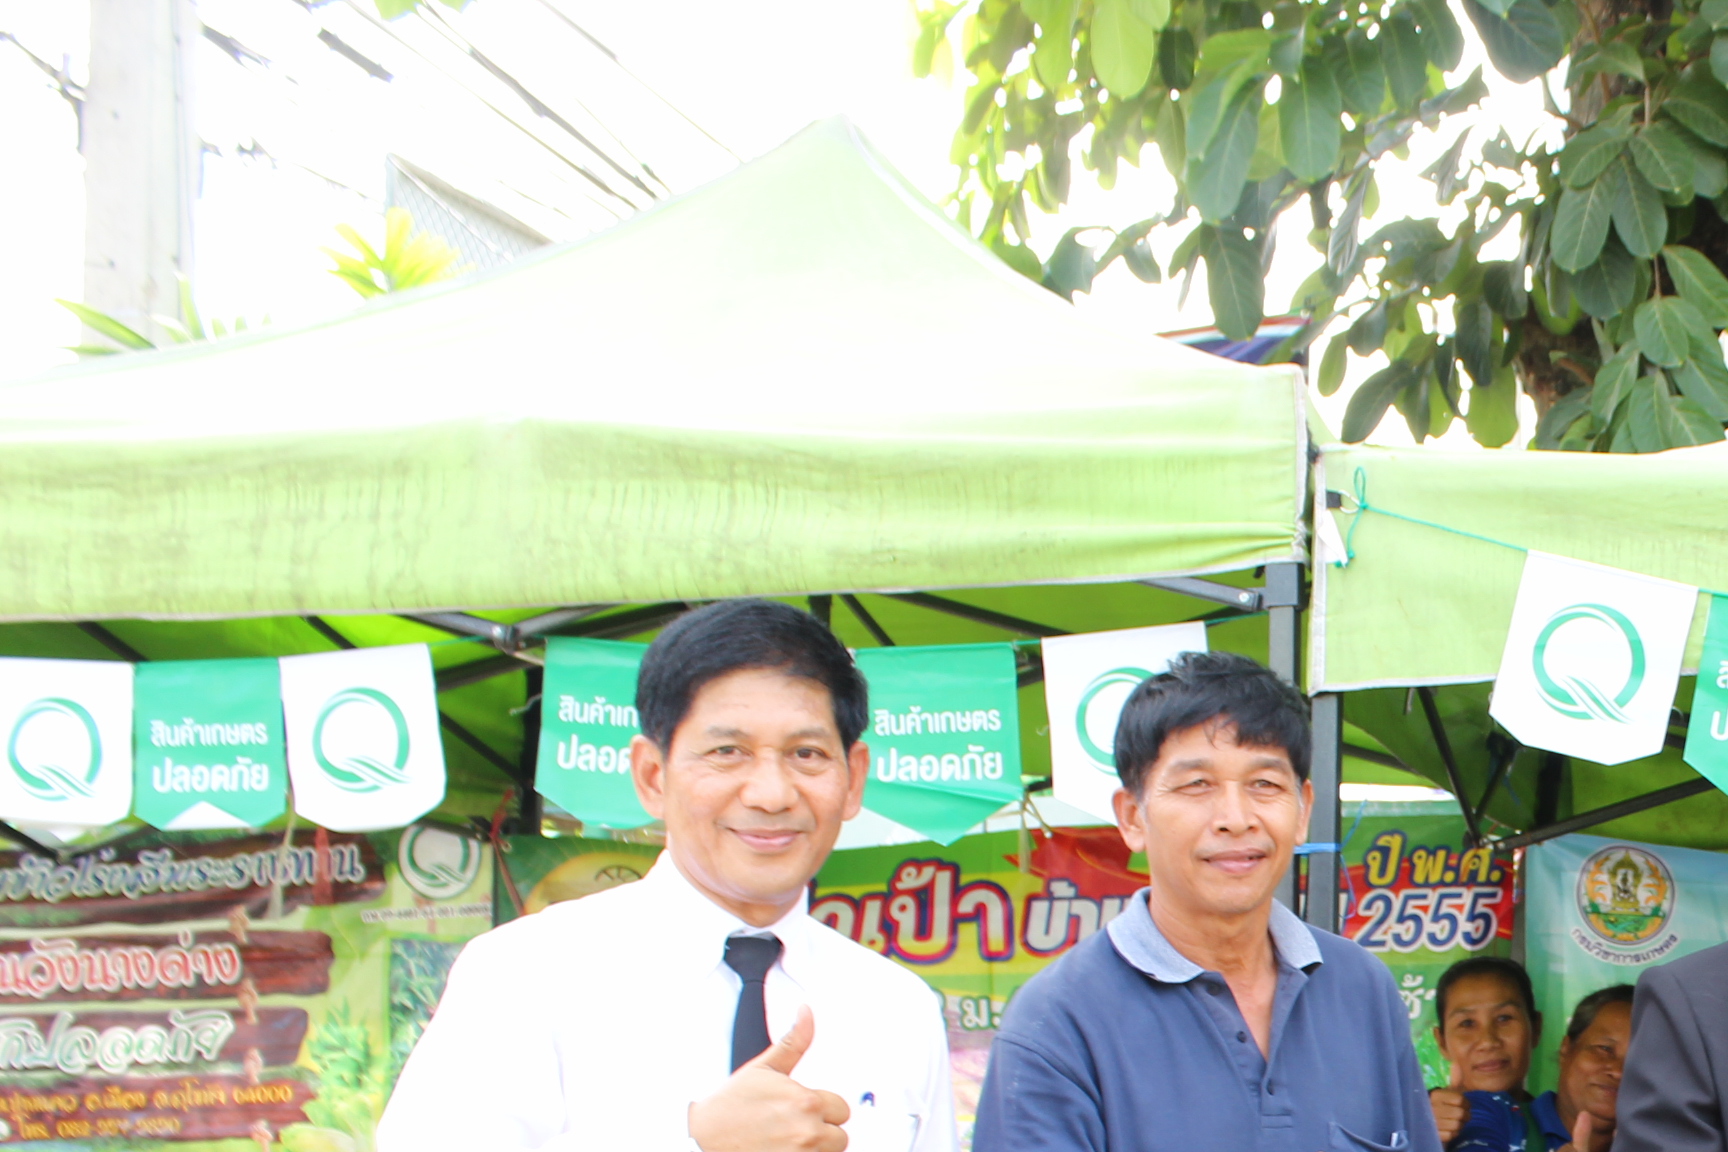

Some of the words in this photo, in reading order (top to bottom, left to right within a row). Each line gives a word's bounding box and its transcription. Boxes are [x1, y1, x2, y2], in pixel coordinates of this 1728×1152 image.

[150, 716, 268, 750] สินค้าเกษตร
[874, 704, 1001, 738] สินค้าเกษตร
[152, 756, 269, 793] ปลอดภัย
[876, 743, 1003, 784] ปลอดภัย
[1366, 833, 1404, 886] ปี
[1358, 890, 1500, 949] 2555
